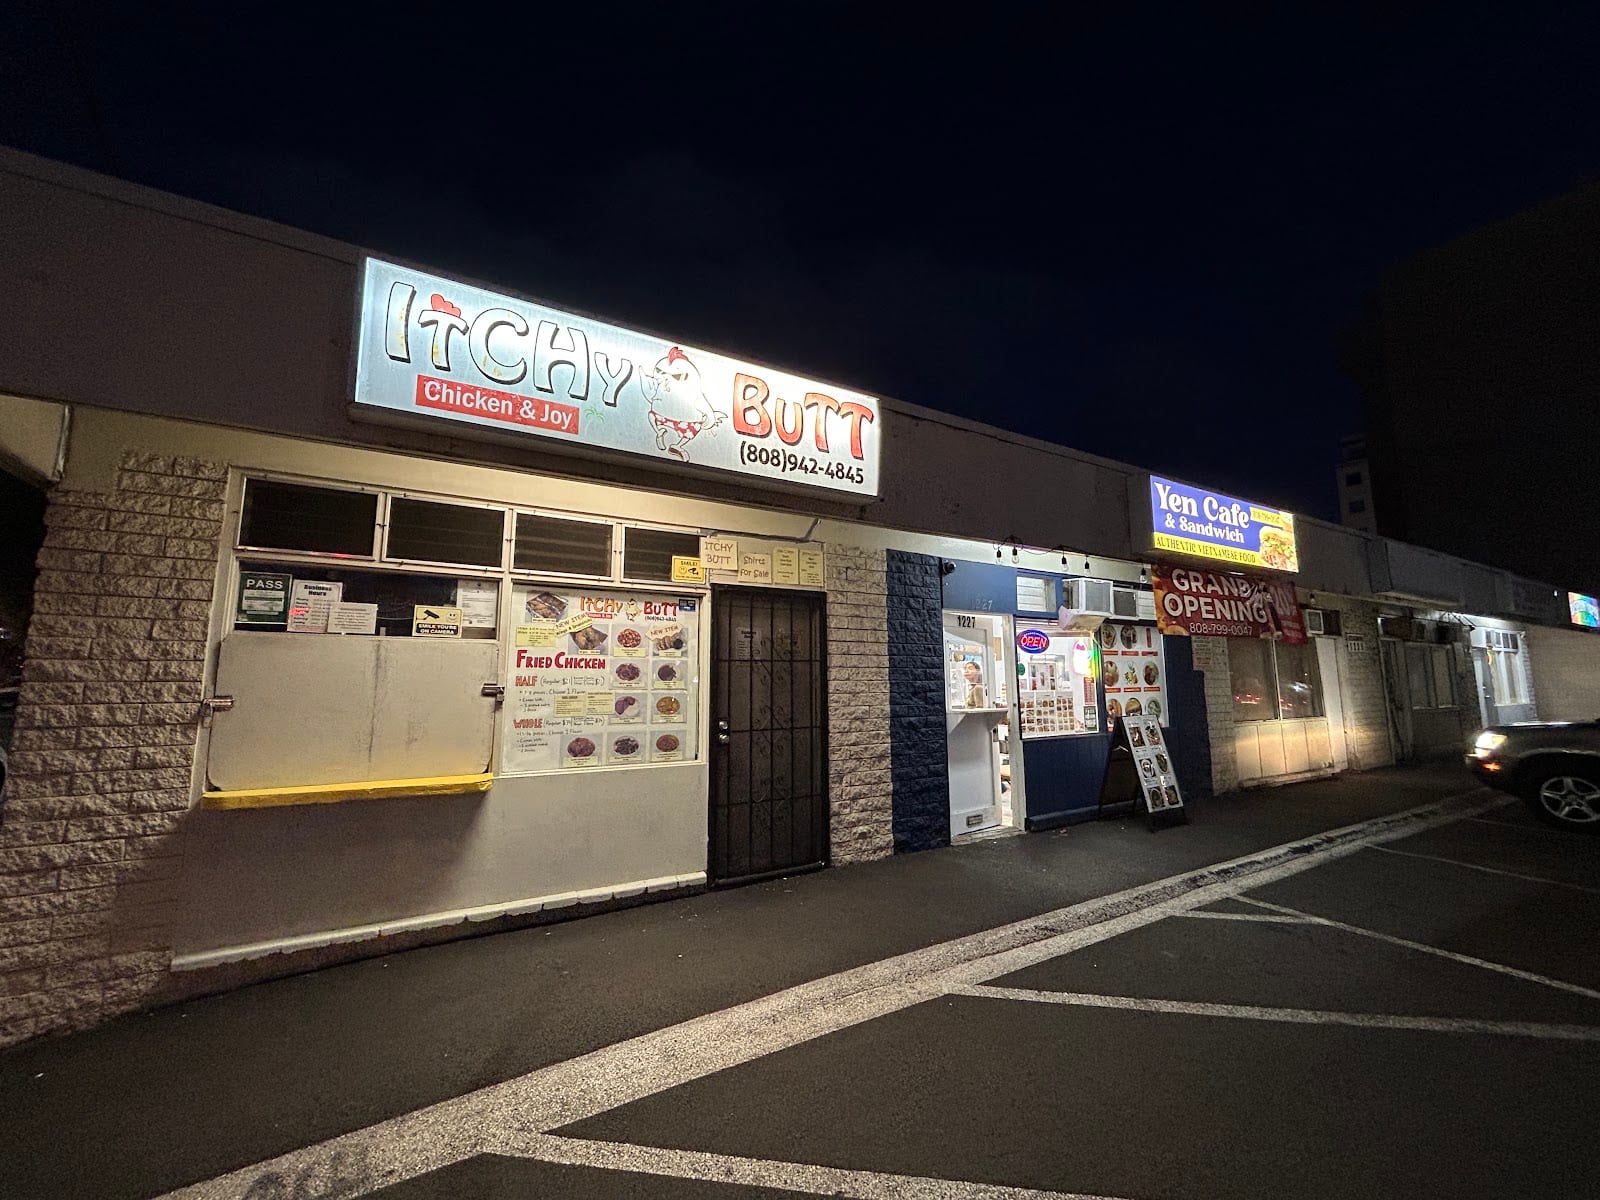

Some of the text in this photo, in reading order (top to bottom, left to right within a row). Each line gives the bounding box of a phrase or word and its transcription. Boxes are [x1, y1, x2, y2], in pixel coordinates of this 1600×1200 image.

[423, 379, 573, 433] Chicken & Joy
[733, 372, 874, 460] BUTT
[740, 439, 865, 485] (808)942-4845
[1154, 482, 1199, 517] Yen
[1203, 496, 1249, 529] Cafe
[1165, 513, 1245, 543] & Sandwich
[704, 541, 733, 553] ITCHY
[1156, 536, 1256, 564] AUTHENTIC VIETNAMESE FOOD
[706, 554, 731, 565] BUTT
[743, 556, 765, 565] Shirts
[753, 569, 769, 578] Sale
[246, 579, 284, 590] PASS
[303, 584, 332, 592] Business
[1171, 568, 1252, 598] GRAND
[643, 600, 679, 617] BUTT
[1163, 593, 1268, 623] OPENING
[957, 614, 976, 629] 1227
[650, 625, 679, 637] NEW ITEM
[1020, 636, 1047, 648] OPEN
[516, 649, 552, 669] FRIED
[554, 651, 606, 670] CHICKEN
[515, 675, 538, 687] HALF
[513, 718, 543, 729] WHOLE
